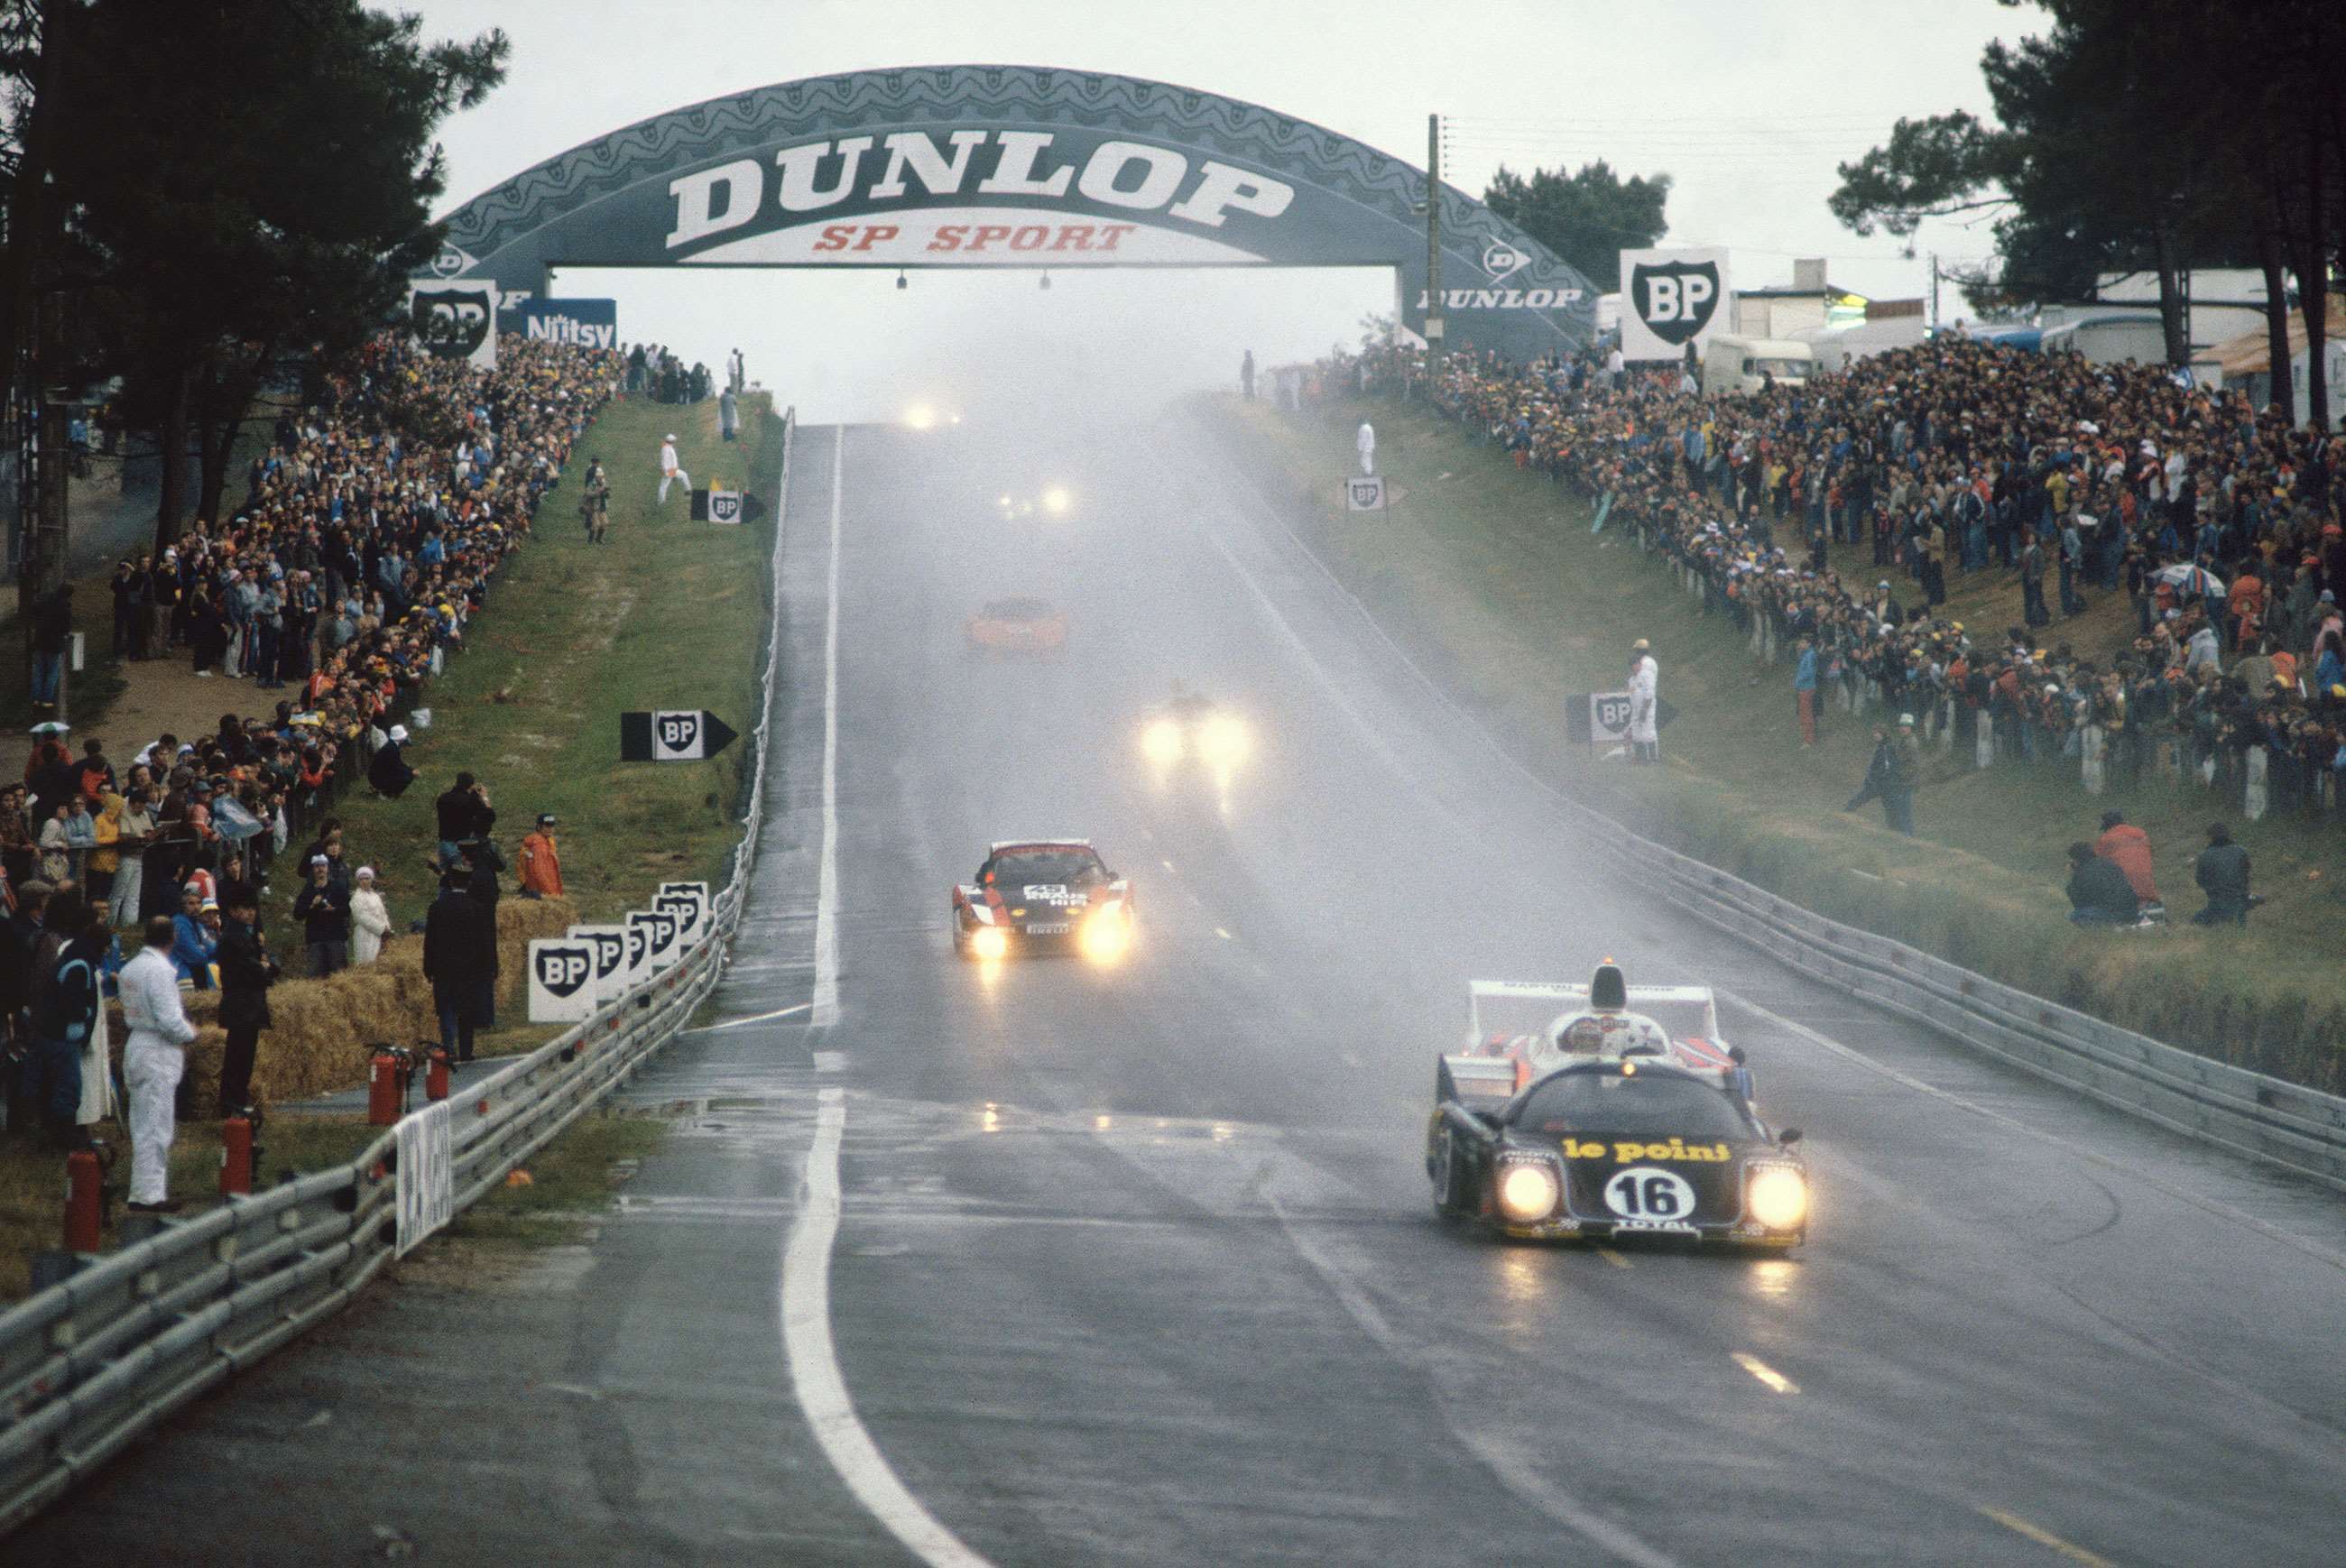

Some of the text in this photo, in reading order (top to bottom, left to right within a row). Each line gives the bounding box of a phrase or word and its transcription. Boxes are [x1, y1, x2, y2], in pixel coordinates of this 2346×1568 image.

[666, 131, 1295, 249] DUNLOP
[812, 225, 1135, 252] SP SPORT
[1645, 274, 1713, 322] BP
[1355, 487, 1377, 503] BP
[716, 499, 737, 515] BP
[1602, 703, 1630, 723] BP
[663, 721, 695, 743] BP
[543, 956, 586, 985] BP
[1562, 1138, 1606, 1158] le
[1615, 1176, 1679, 1216] 16
[1616, 1219, 1697, 1233] TOTAL
